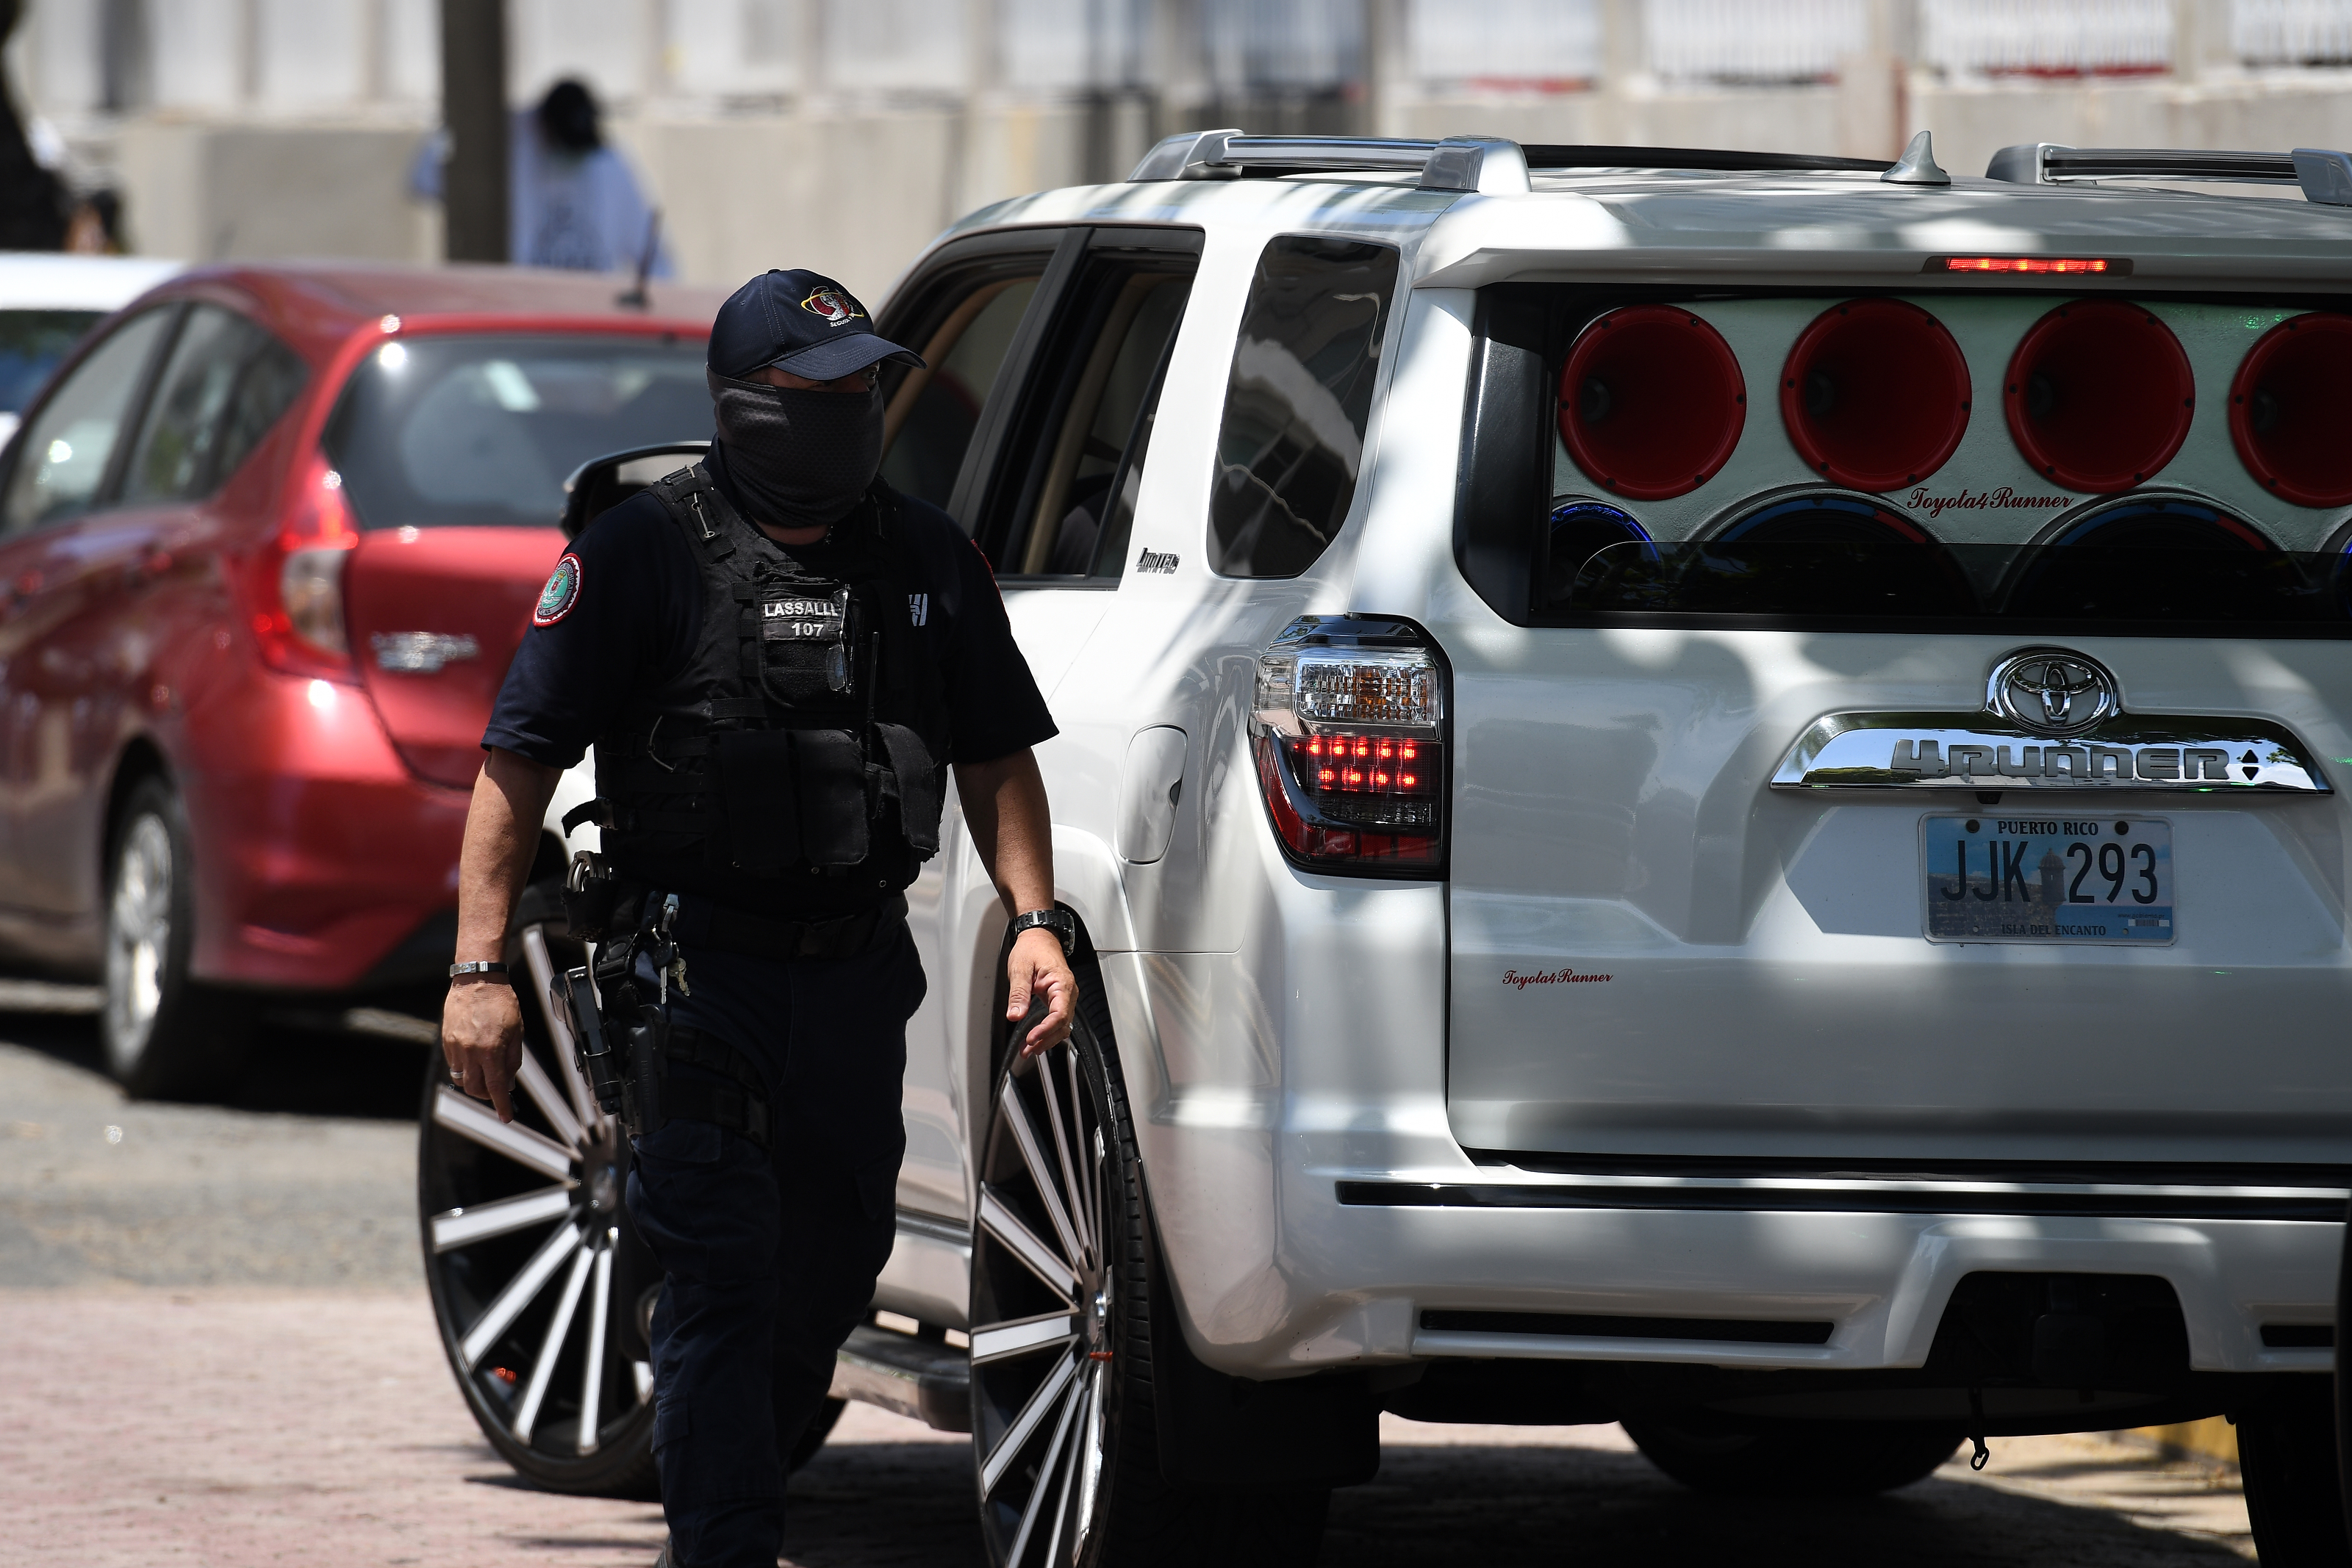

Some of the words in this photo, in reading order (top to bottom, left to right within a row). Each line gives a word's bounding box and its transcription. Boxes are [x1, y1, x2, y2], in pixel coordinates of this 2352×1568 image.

[792, 622, 824, 637] 107
[1997, 820, 2057, 835] PUERTO
[2063, 821, 2099, 836] RICO
[1940, 840, 2031, 903] JJK
[2066, 842, 2159, 905] 293
[2001, 924, 2027, 935] ISLA
[2030, 924, 2052, 935] DEL
[2054, 924, 2107, 936] ENCANTO
